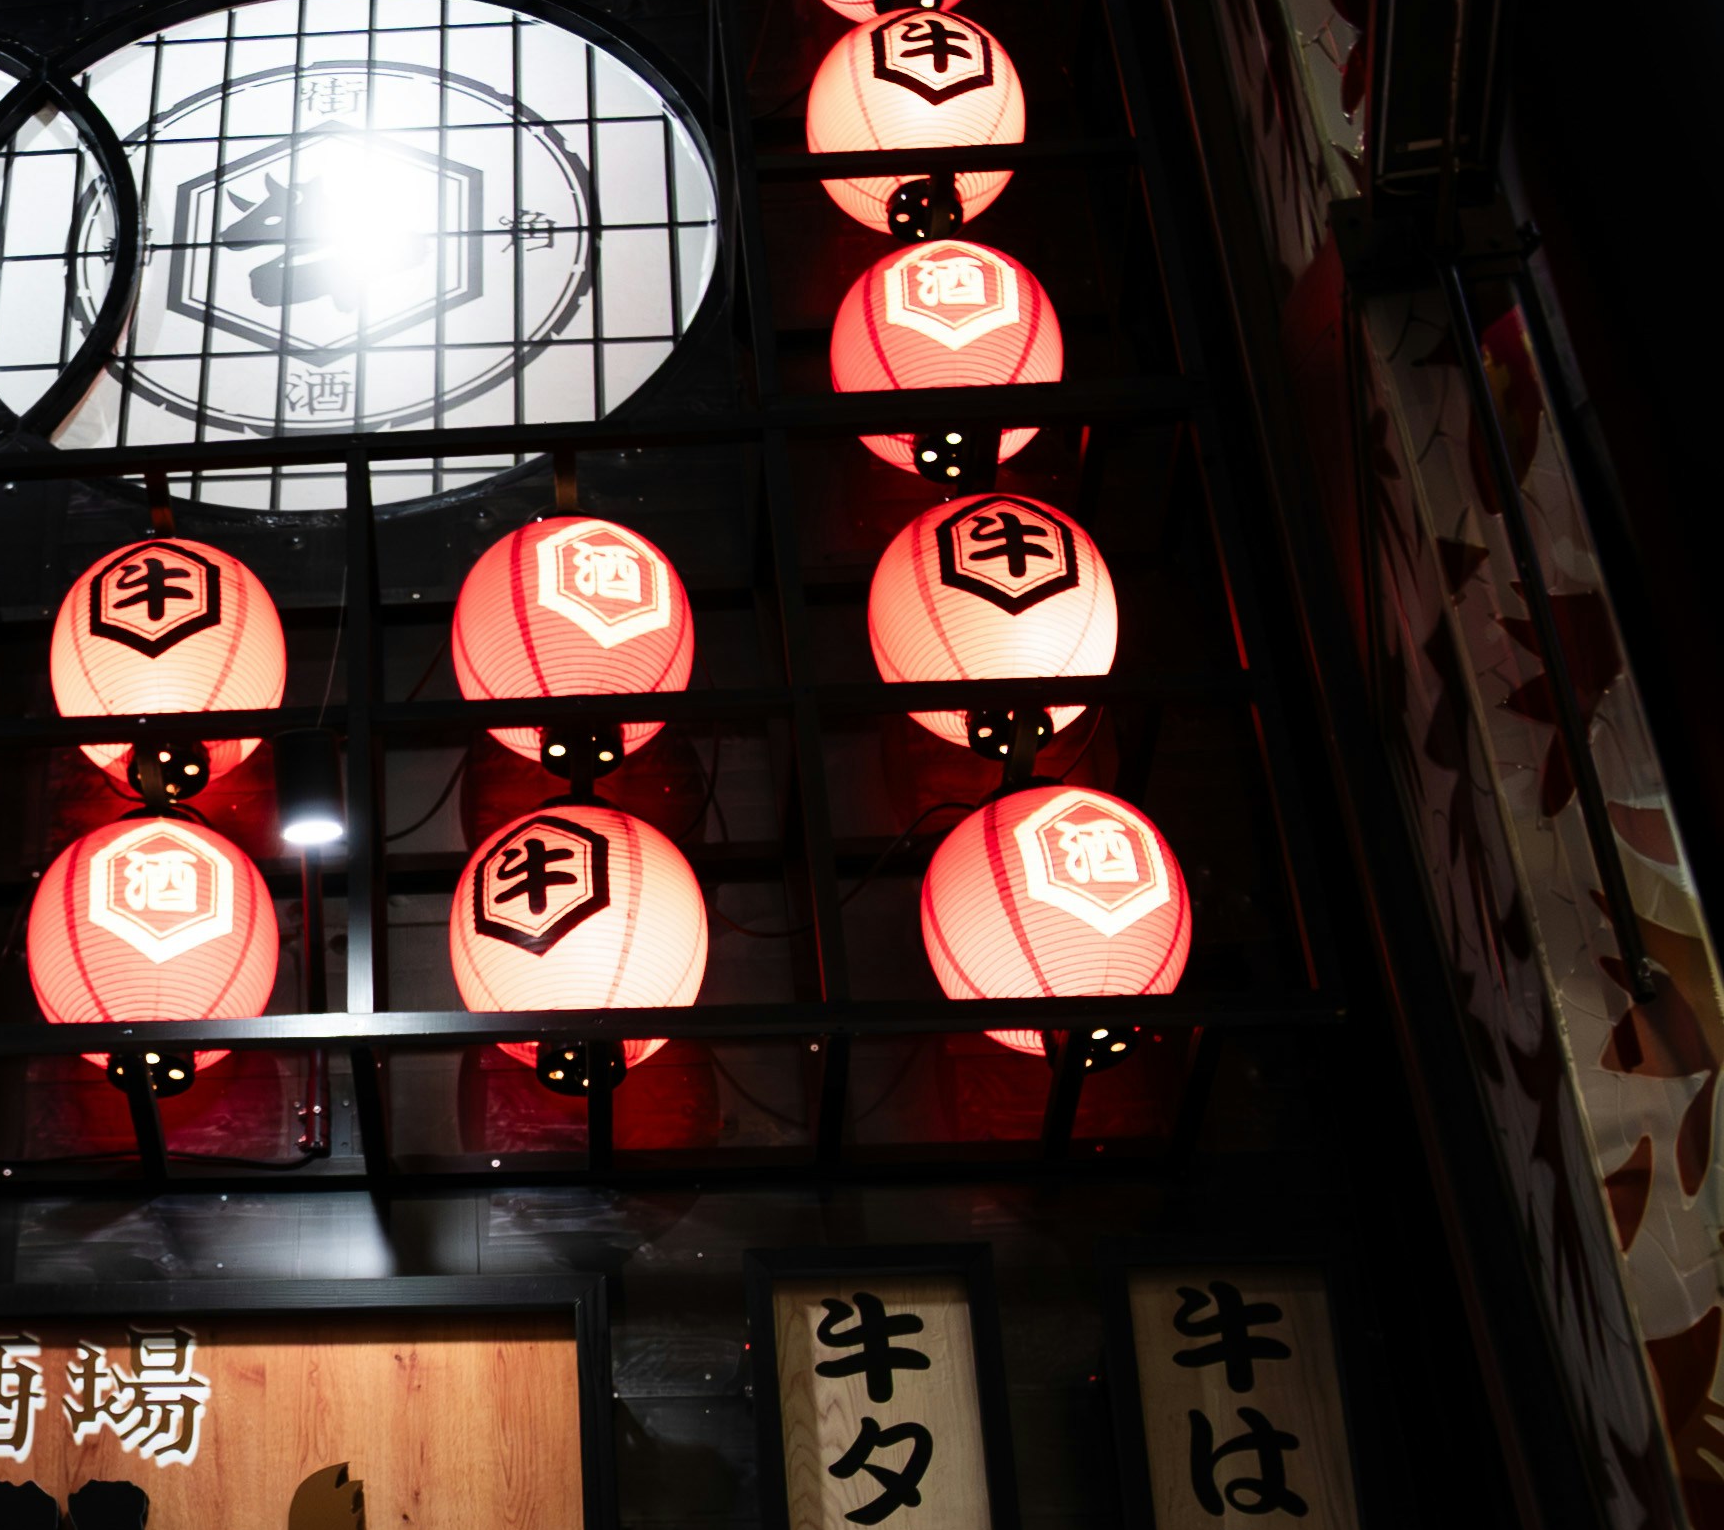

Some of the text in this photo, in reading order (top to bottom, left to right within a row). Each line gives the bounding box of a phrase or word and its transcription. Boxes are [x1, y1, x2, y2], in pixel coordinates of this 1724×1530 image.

[900, 18, 973, 73] 牛
[498, 209, 557, 253] 角
[917, 259, 987, 307] 酒
[284, 368, 354, 416] 酒
[573, 540, 643, 604] 酒
[968, 511, 1055, 577] 牛
[114, 556, 195, 622] 牛
[123, 850, 198, 914] 酒
[493, 838, 578, 916] 牛
[1056, 819, 1140, 885] 酒
